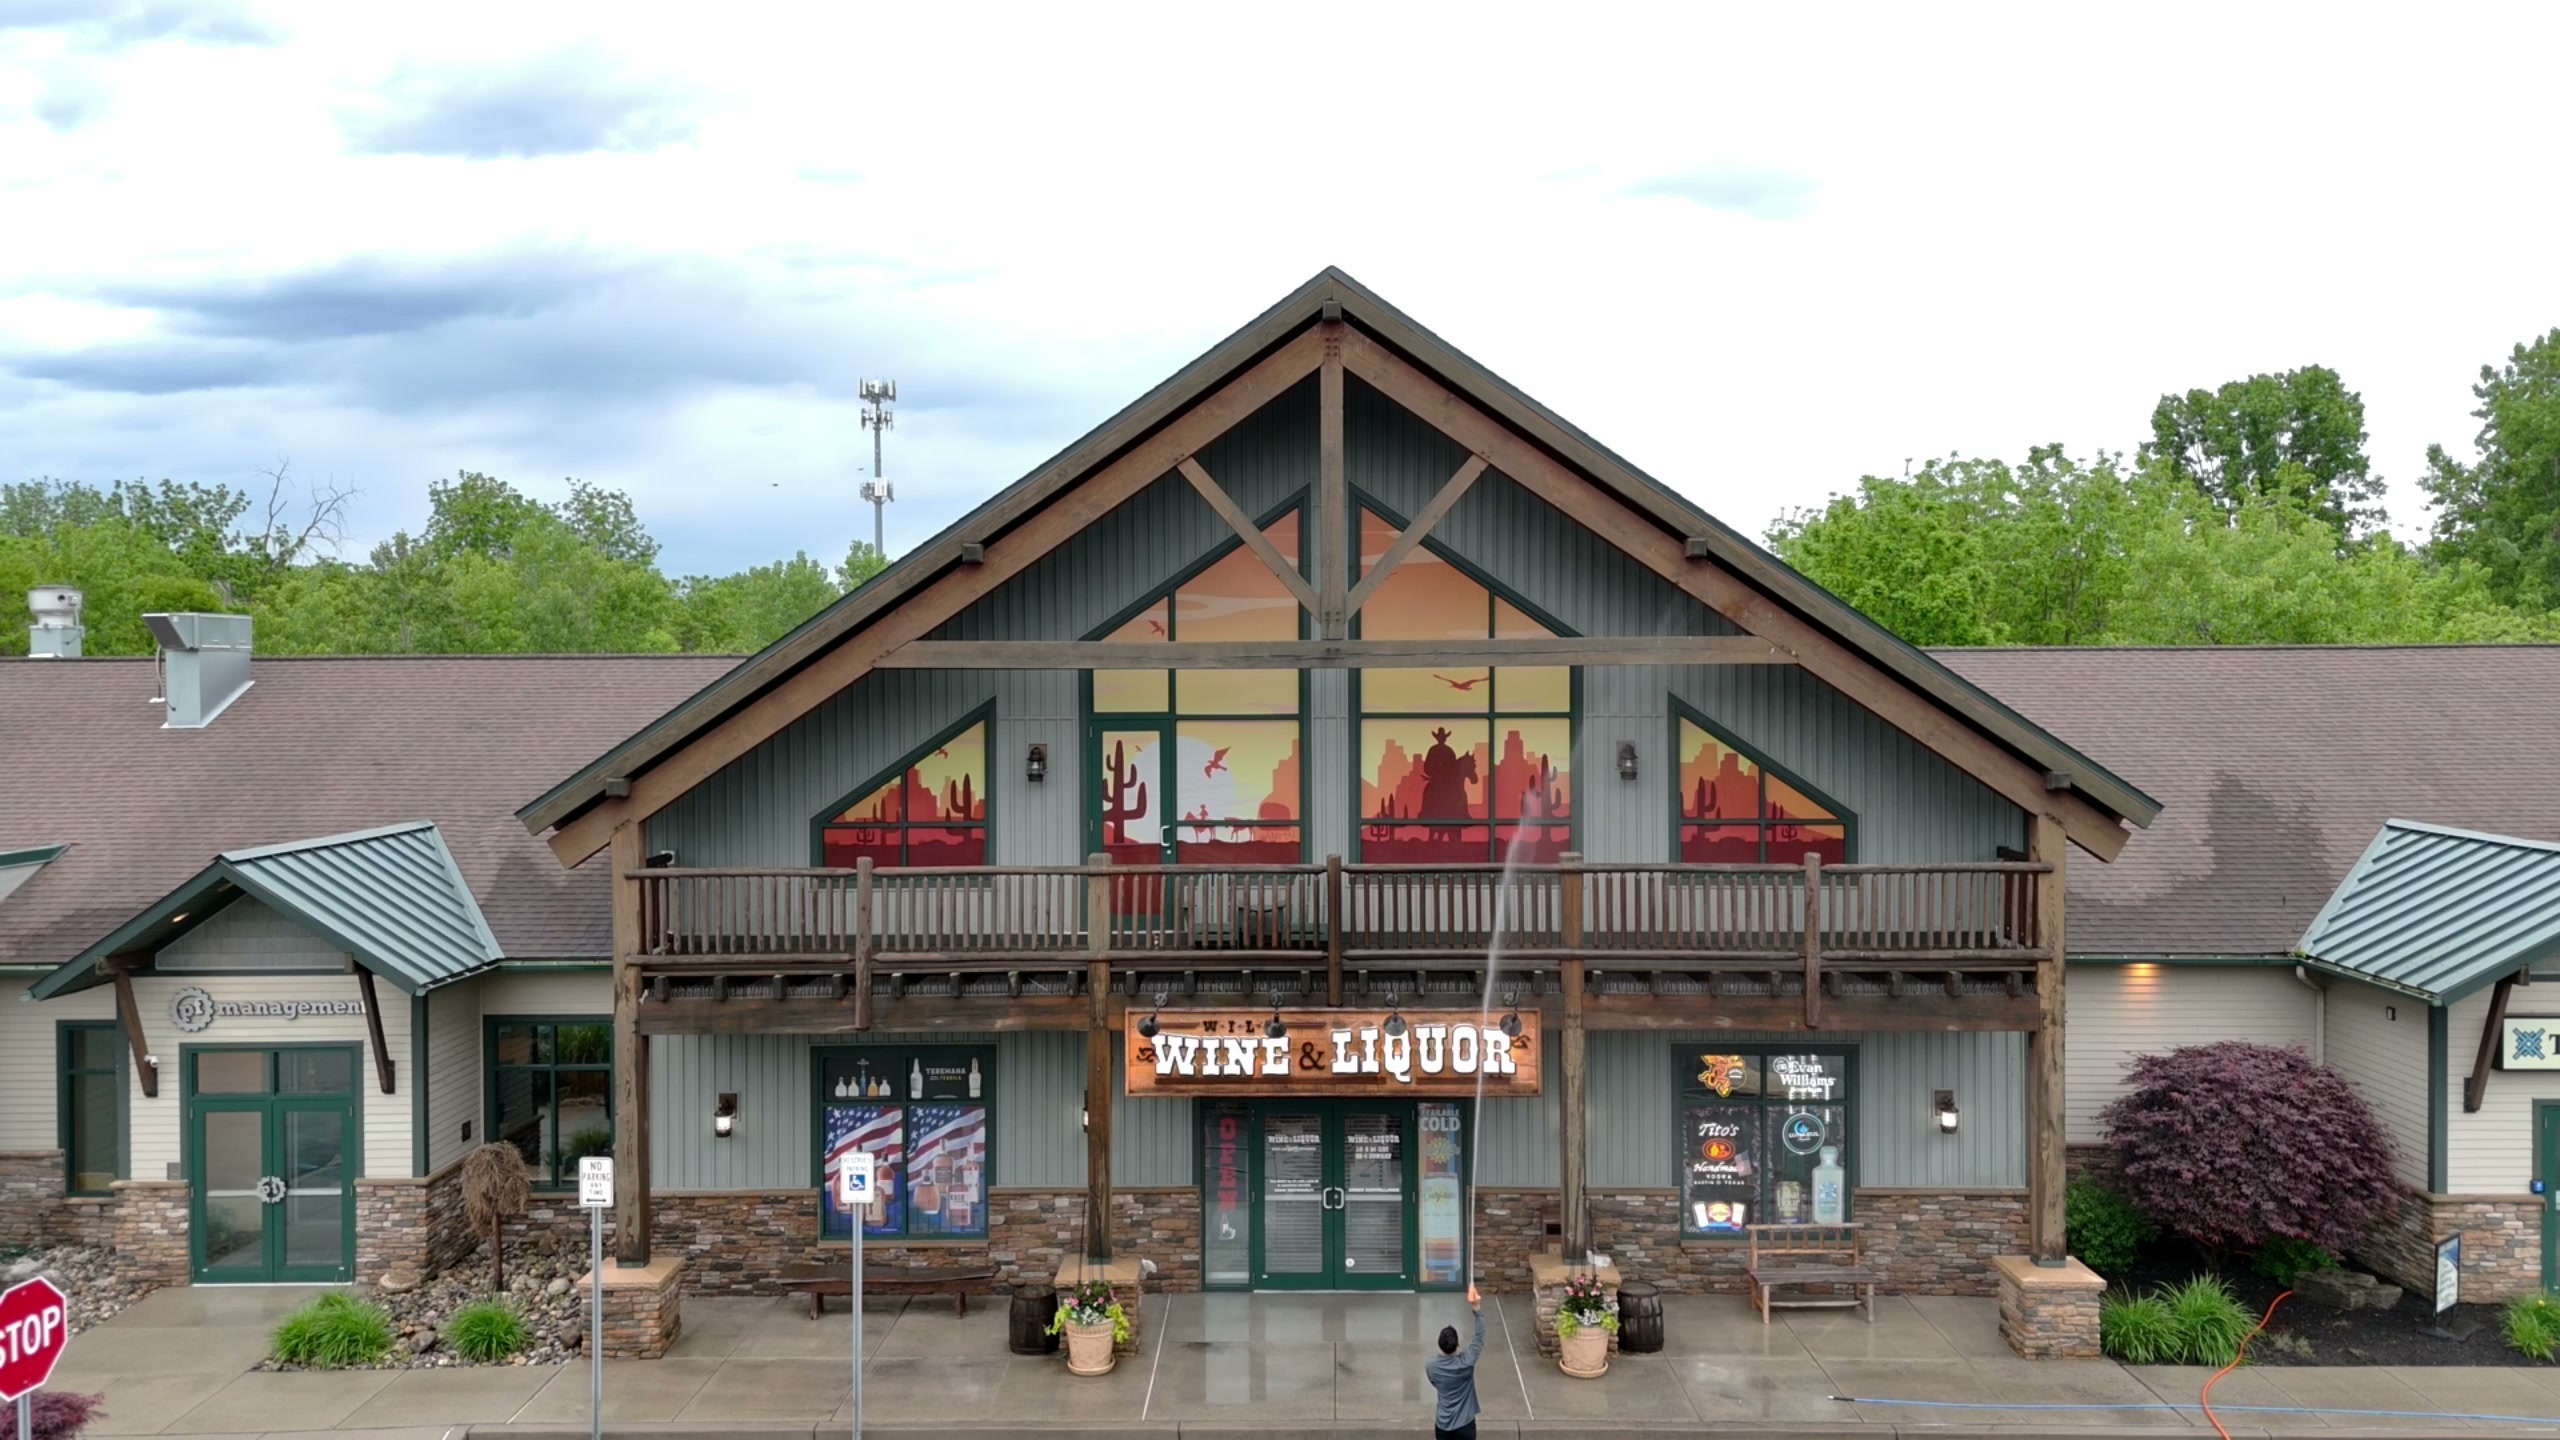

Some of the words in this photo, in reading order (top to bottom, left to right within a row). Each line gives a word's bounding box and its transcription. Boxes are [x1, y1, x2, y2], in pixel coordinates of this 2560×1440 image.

[1151, 1032, 1291, 1077] WINE
[1299, 1041, 1326, 1071] &
[1330, 1024, 1518, 1084] LIQUOR
[1788, 1060, 1824, 1074] Evan
[1779, 1073, 1836, 1087] Williams
[1419, 1116, 1461, 1132] COLD
[1698, 1122, 1740, 1137] Tito's
[590, 1161, 602, 1171] NO
[582, 1172, 611, 1182] PARKING
